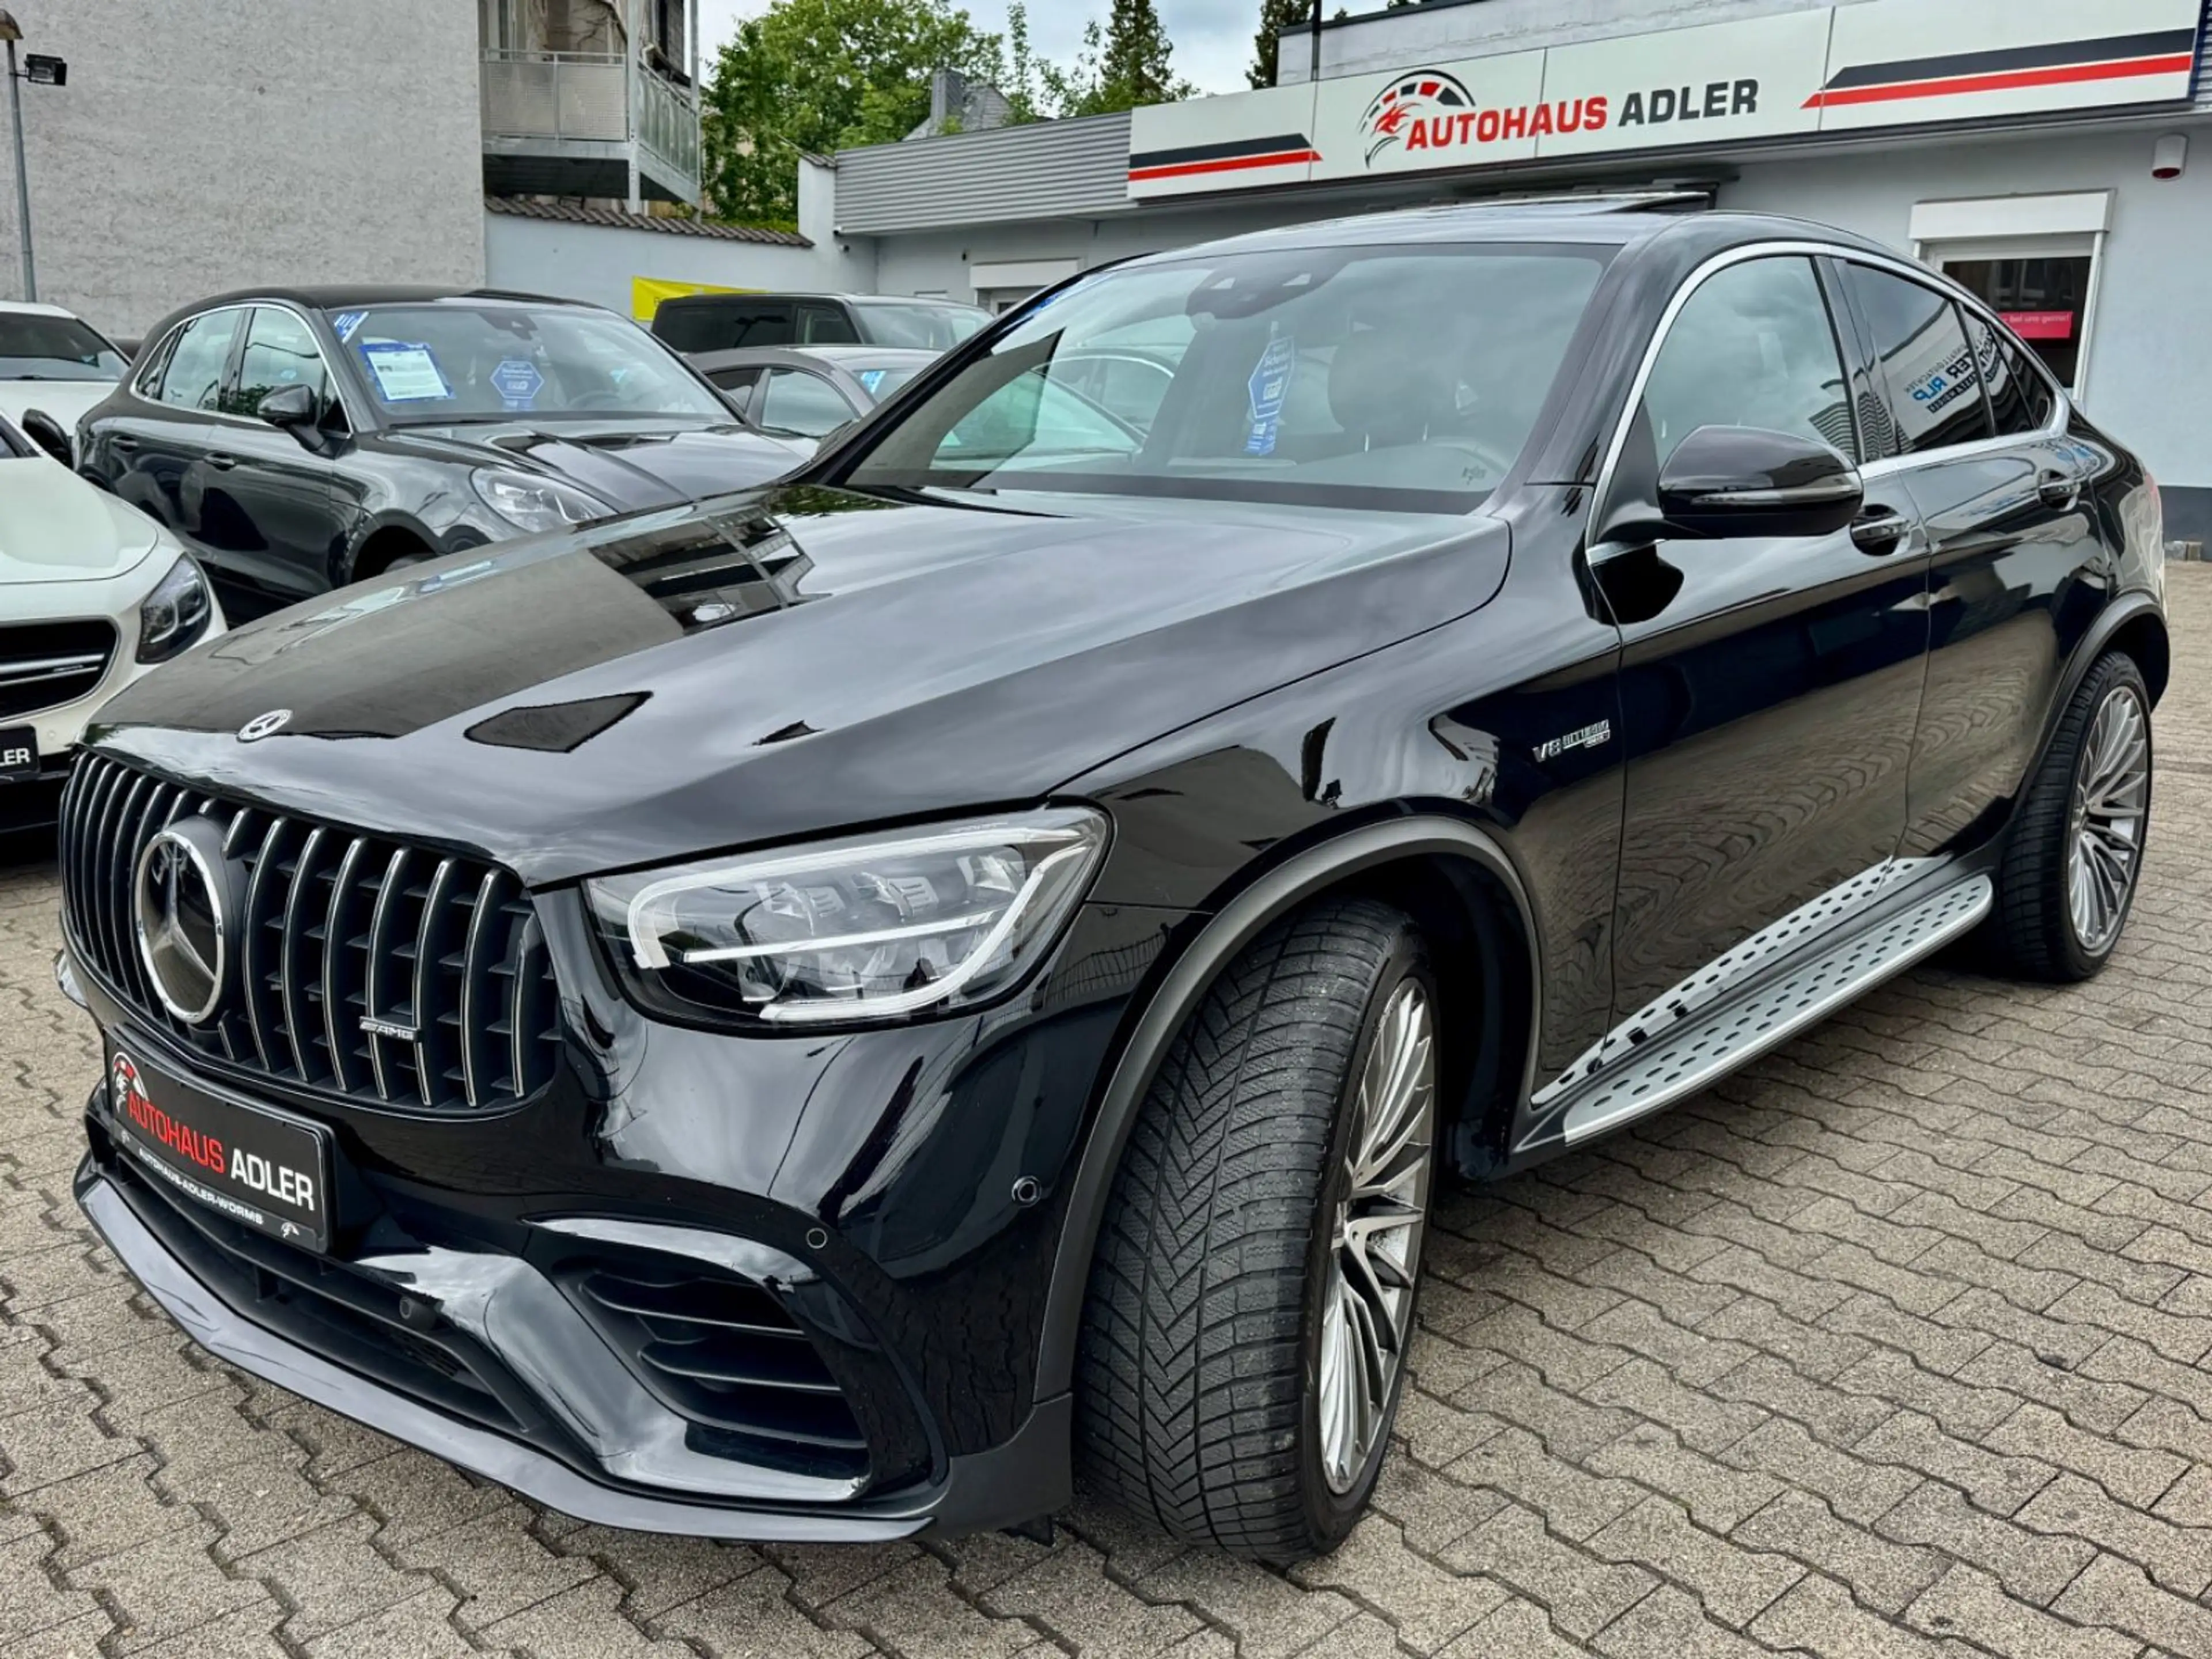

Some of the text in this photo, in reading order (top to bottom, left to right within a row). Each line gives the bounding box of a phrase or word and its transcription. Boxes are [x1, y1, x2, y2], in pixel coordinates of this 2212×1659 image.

[1406, 78, 1759, 151] AUTOHAUS ADLER
[1532, 738, 1562, 763] V8
[376, 1025, 414, 1040] AMG
[128, 1089, 315, 1211] AUTOHAUS ADLER
